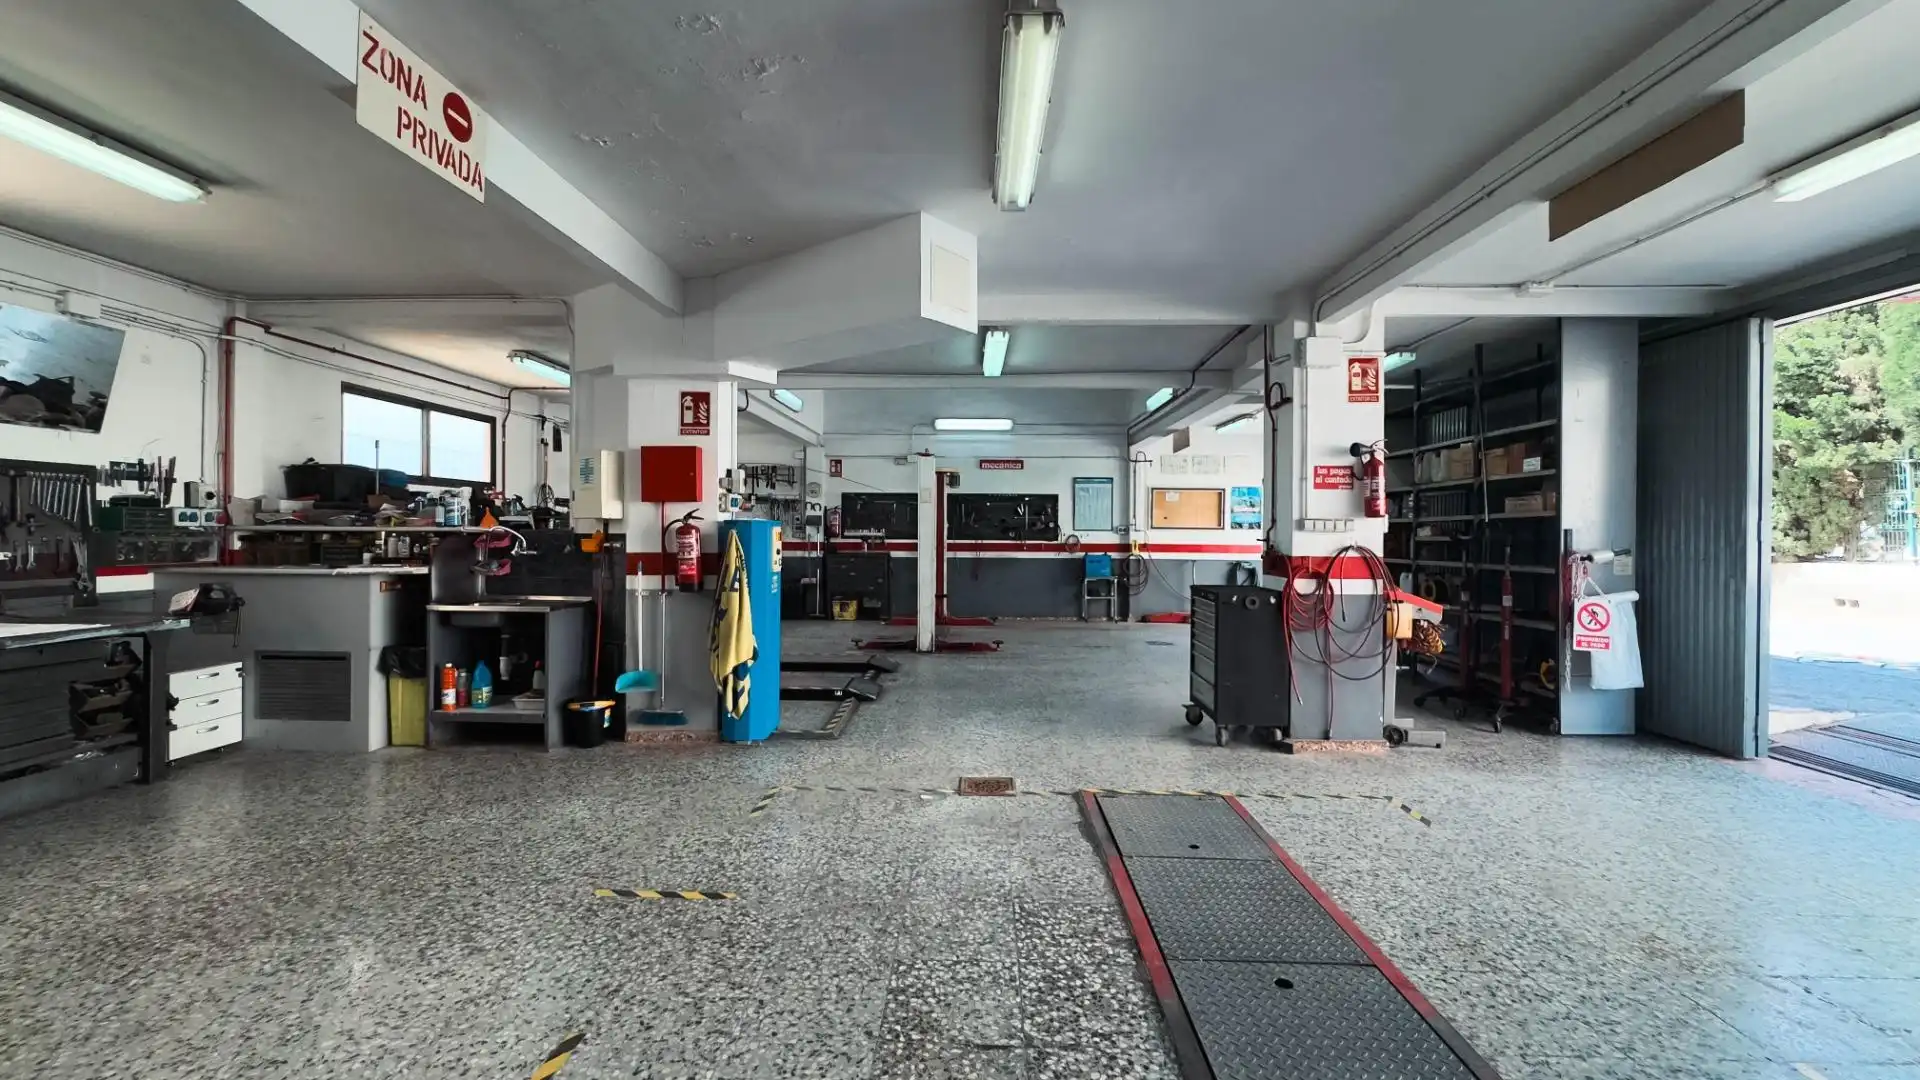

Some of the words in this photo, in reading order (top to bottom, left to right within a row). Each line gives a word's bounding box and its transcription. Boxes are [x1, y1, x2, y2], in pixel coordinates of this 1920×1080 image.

[361, 29, 428, 111] ZONA
[396, 106, 483, 193] PRIVADA
[981, 461, 1022, 469] mecánica
[1315, 475, 1323, 483] al
[1324, 475, 1352, 483] contado
